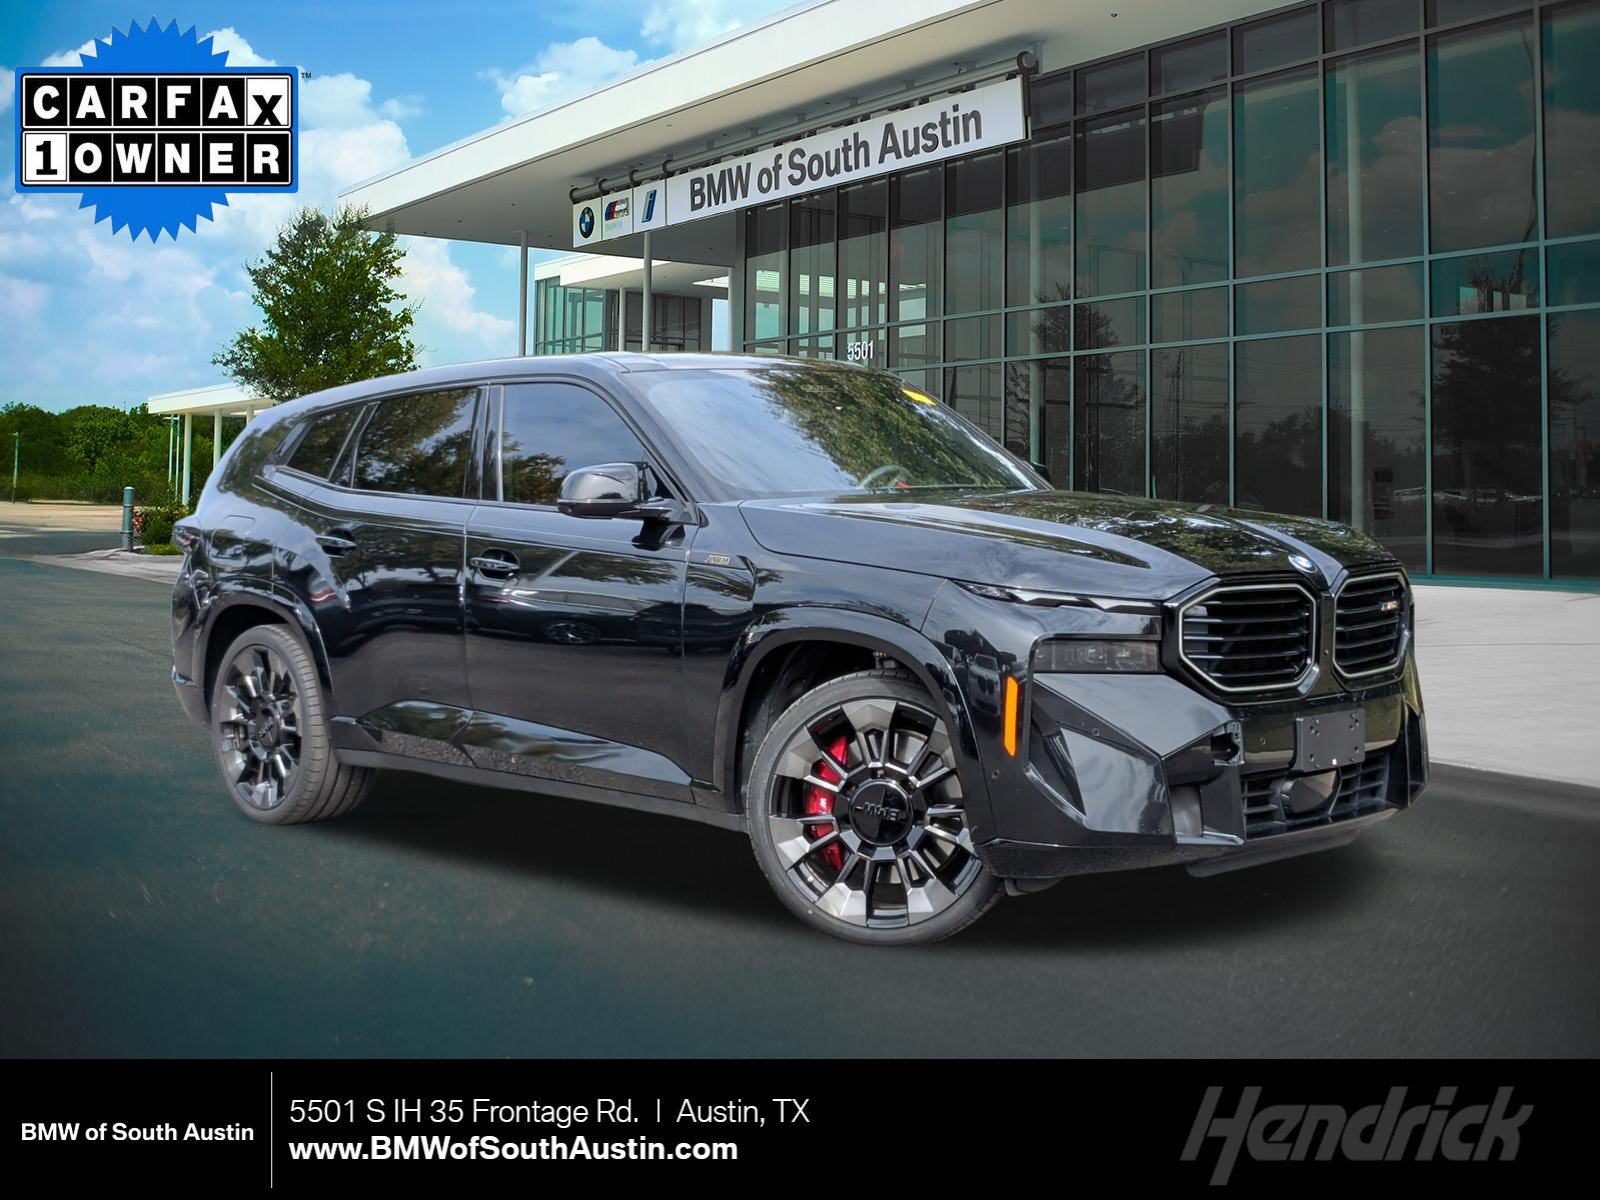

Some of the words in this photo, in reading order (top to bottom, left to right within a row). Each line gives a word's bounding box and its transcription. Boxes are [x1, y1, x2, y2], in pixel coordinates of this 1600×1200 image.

[690, 162, 751, 211] BMW
[757, 153, 783, 194] of
[787, 132, 870, 186] South
[878, 104, 982, 164] Austin
[847, 340, 874, 361] 5501
